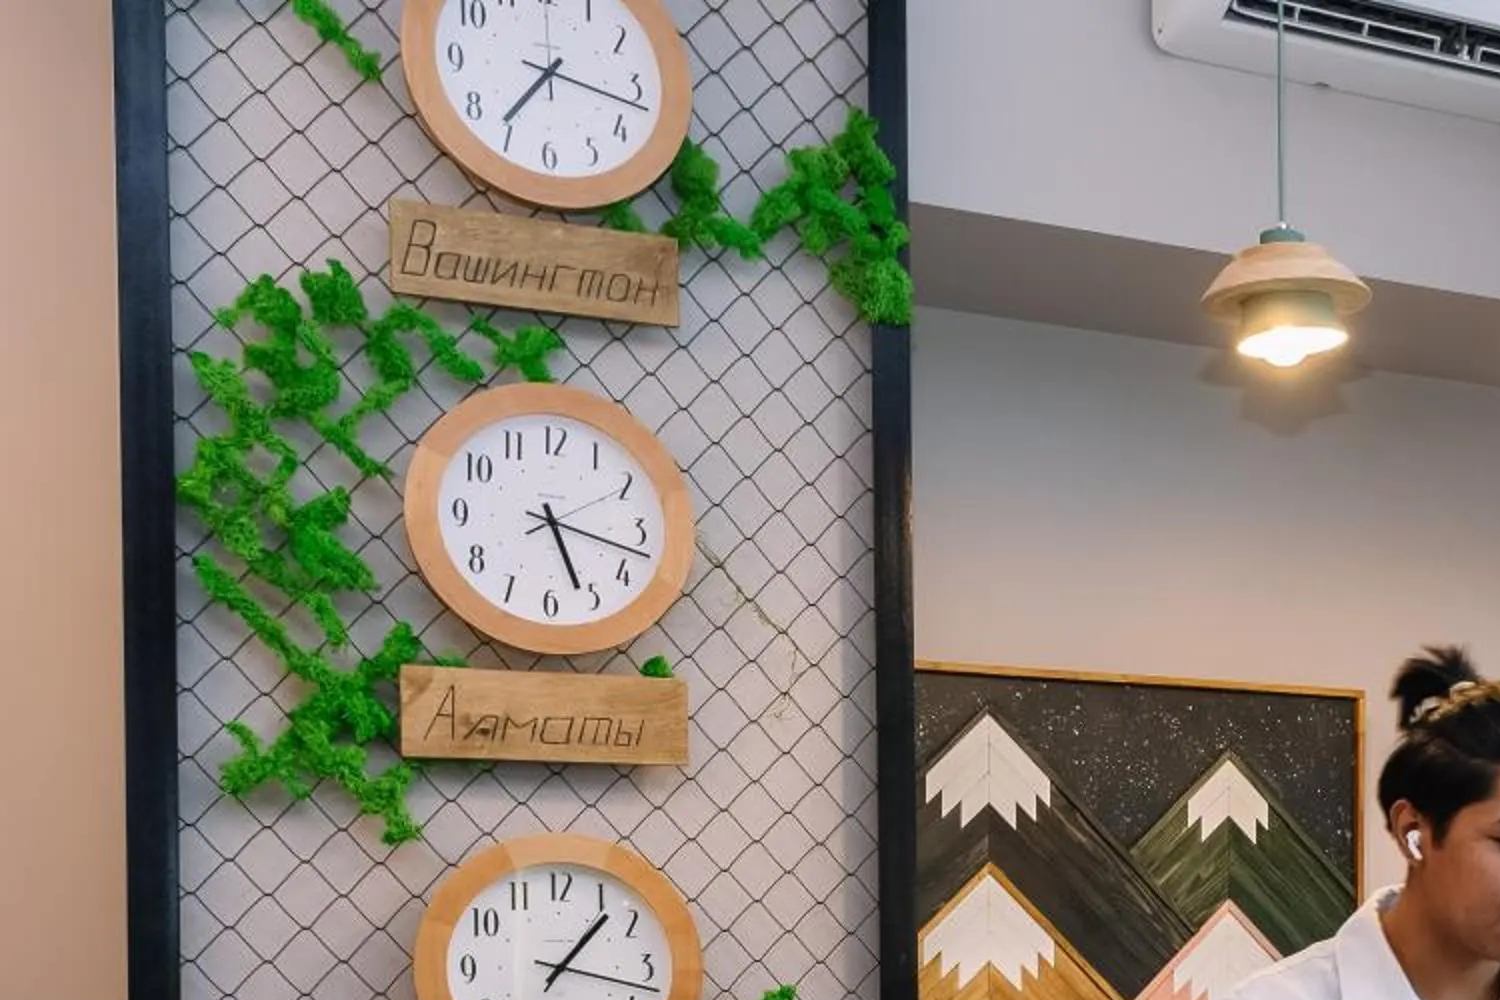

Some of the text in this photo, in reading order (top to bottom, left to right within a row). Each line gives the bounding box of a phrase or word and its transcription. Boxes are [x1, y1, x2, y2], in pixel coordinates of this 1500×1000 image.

[460, 0, 486, 29] 10
[613, 24, 627, 55] 2
[447, 42, 464, 72] 9
[630, 72, 643, 101] 3
[466, 91, 483, 121] 8
[612, 114, 627, 143] 4
[541, 142, 557, 170] 6
[586, 137, 599, 166] 5
[400, 218, 661, 306] Вашингтон
[504, 430, 522, 460] 11
[544, 425, 567, 457] 12
[466, 452, 493, 483] 10
[618, 471, 633, 501] 2
[452, 498, 469, 527] 9
[634, 517, 647, 546] 3
[468, 544, 485, 574] 8
[615, 558, 630, 587] 4
[504, 573, 515, 603] 7
[588, 583, 601, 611] 5
[543, 589, 559, 618] 6
[423, 684, 646, 747] Алматы
[508, 881, 528, 911] 11
[550, 872, 573, 902] 12
[471, 907, 500, 937] 10
[625, 909, 639, 938] 2
[460, 954, 477, 985] 9
[640, 953, 654, 982] 3
